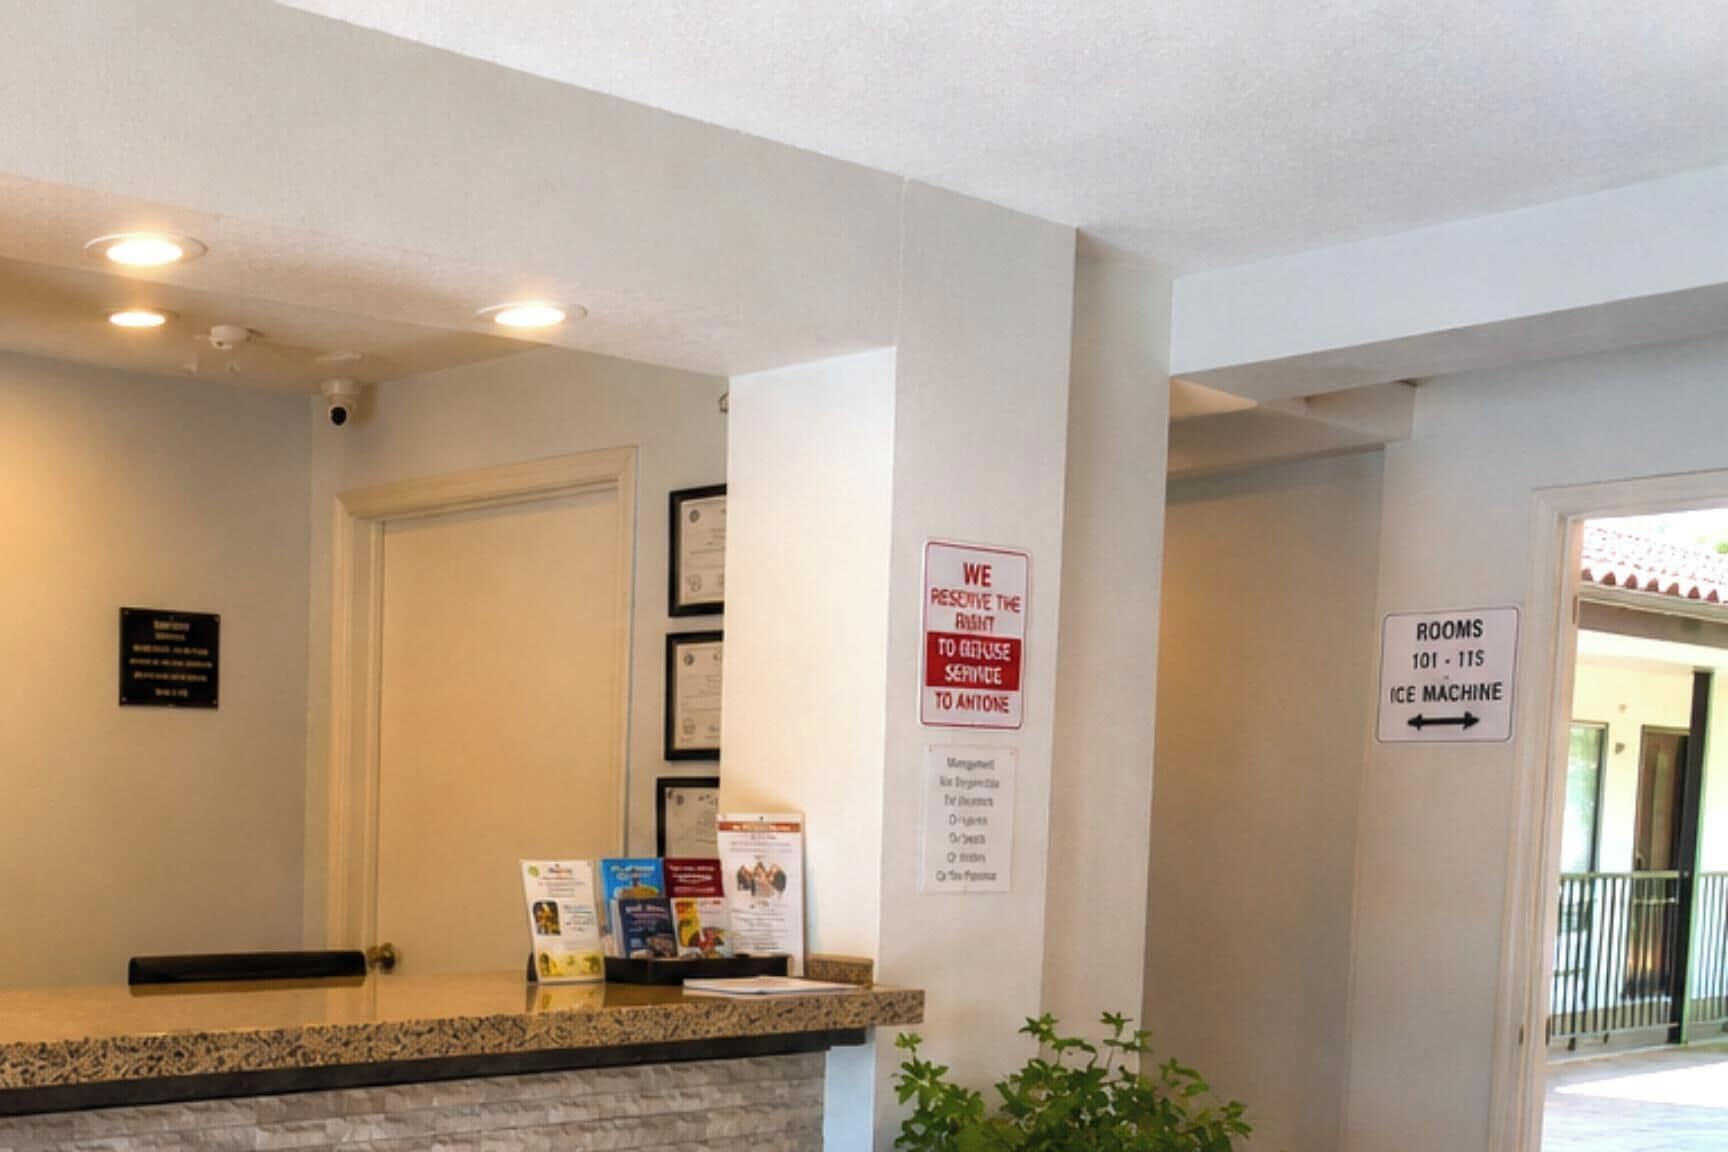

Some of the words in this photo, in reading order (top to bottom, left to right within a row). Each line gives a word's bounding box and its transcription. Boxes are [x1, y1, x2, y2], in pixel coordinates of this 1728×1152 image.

[963, 561, 991, 587] WE
[996, 594, 1020, 613] THE
[1416, 618, 1483, 640] ROOMS
[937, 638, 954, 657] TO
[1412, 651, 1437, 669] 101
[934, 691, 952, 710] TO
[1389, 685, 1416, 703] ICE
[1423, 681, 1502, 702] MACHINE
